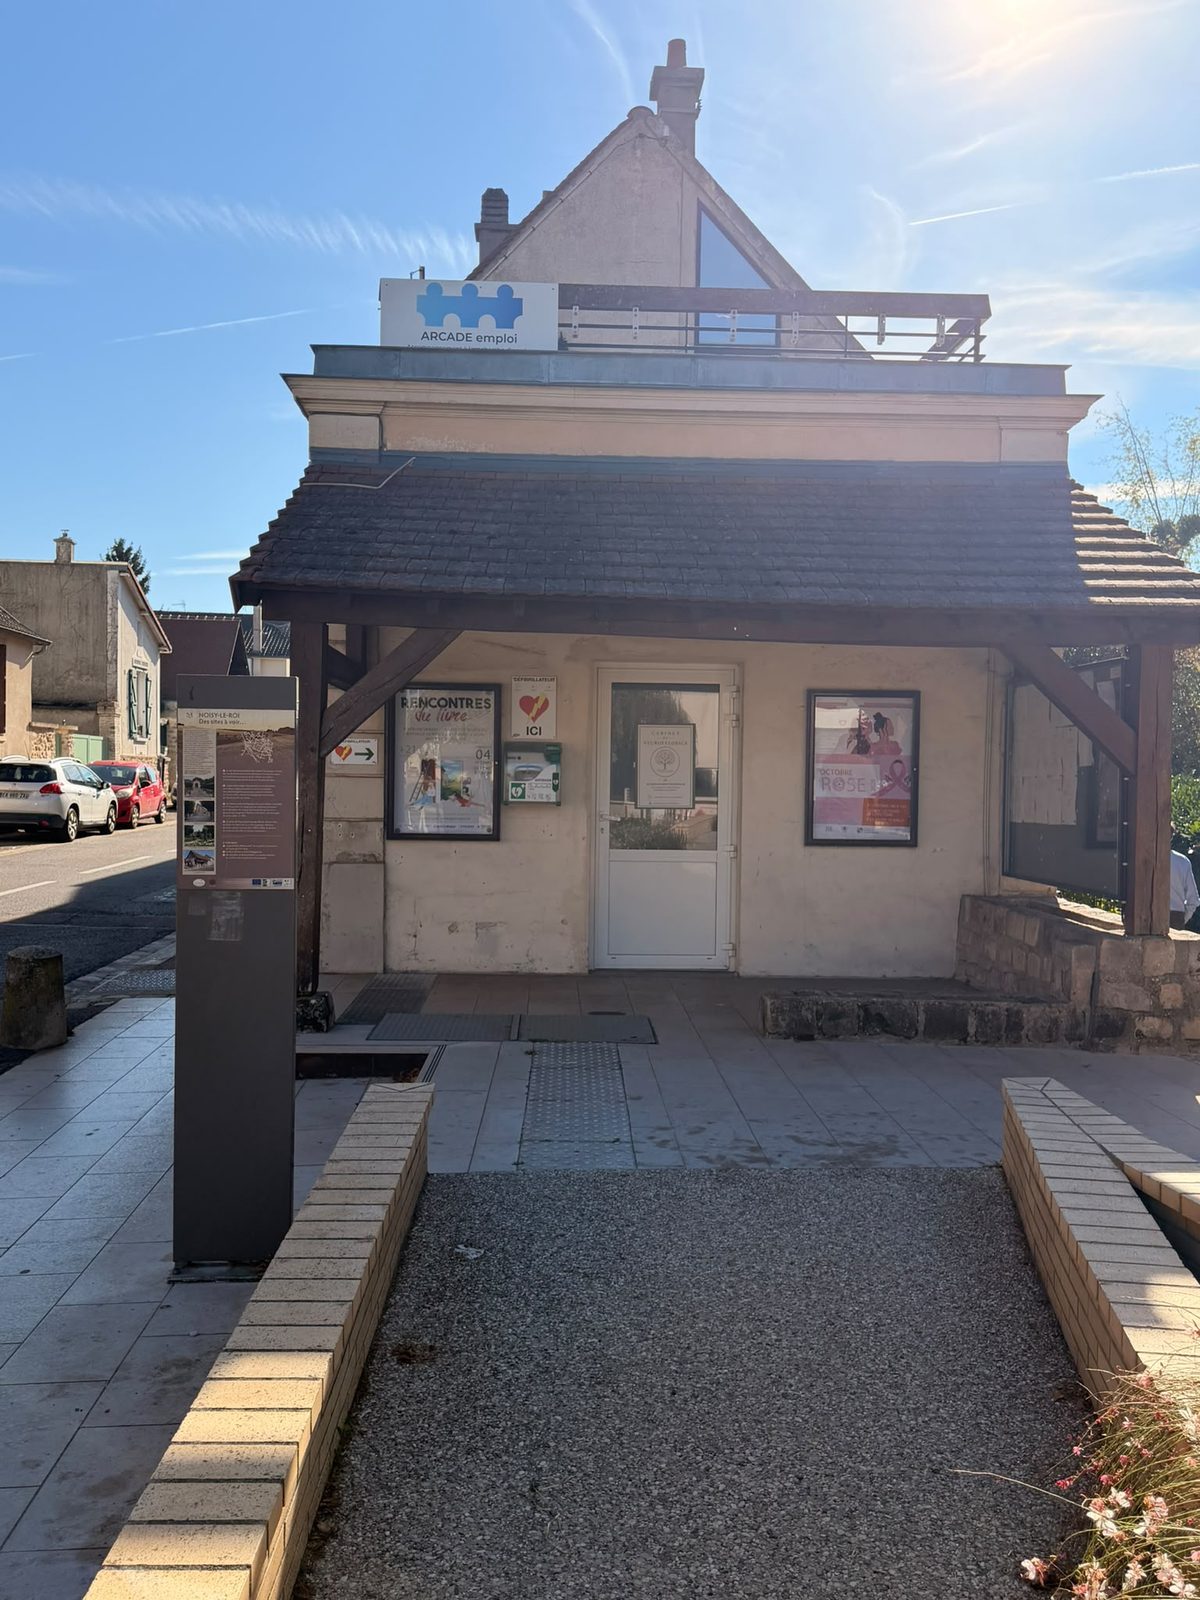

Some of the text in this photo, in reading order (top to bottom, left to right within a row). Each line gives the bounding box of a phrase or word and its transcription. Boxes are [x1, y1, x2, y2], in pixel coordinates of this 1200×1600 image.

[420, 331, 518, 345] ARCADE emploi
[401, 697, 491, 709] RENCONTRES
[198, 711, 240, 719] NOISY-LE-ROI
[526, 726, 542, 736] ICI
[475, 749, 491, 760] 04
[821, 776, 866, 792] ROSE
